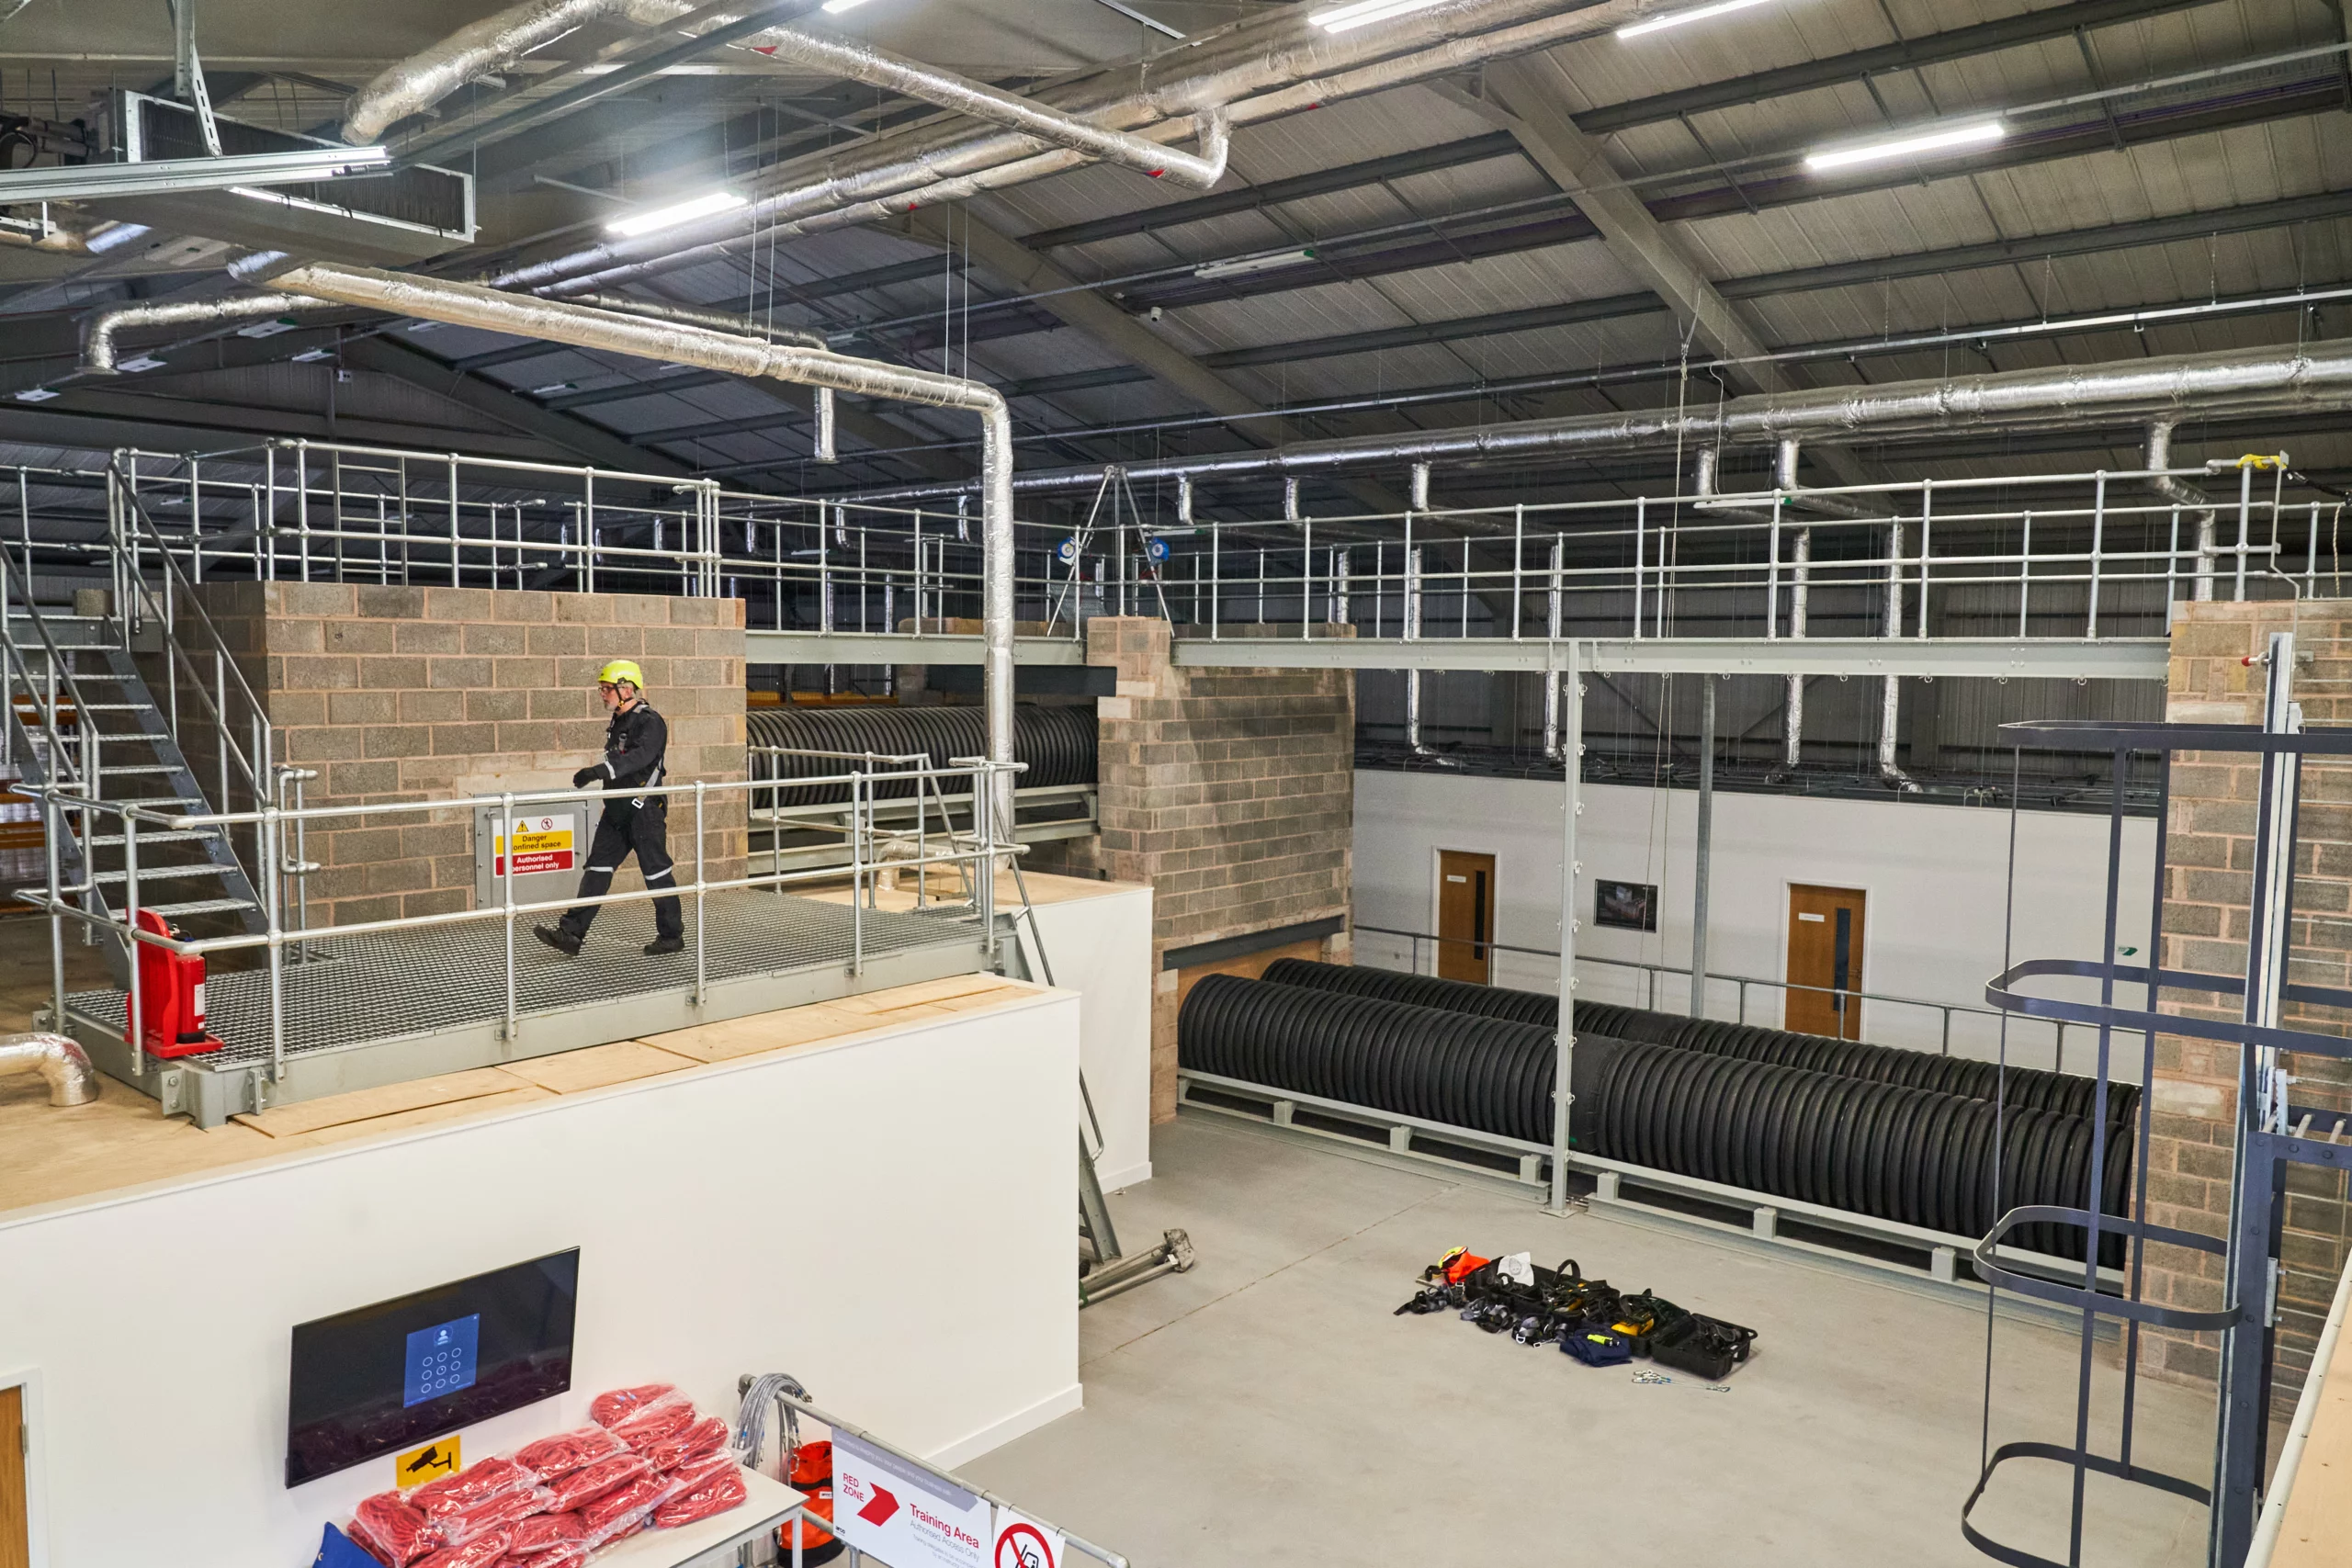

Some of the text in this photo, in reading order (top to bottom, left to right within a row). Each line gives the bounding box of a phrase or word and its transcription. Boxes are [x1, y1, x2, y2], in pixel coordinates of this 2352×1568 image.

[513, 842, 539, 851] onfined
[516, 853, 553, 863] Authorised
[842, 1472, 859, 1488] RED
[842, 1483, 865, 1503] ZONE
[910, 1503, 979, 1549] Training Area
[942, 1536, 965, 1553] Access
[965, 1547, 980, 1563] Only
